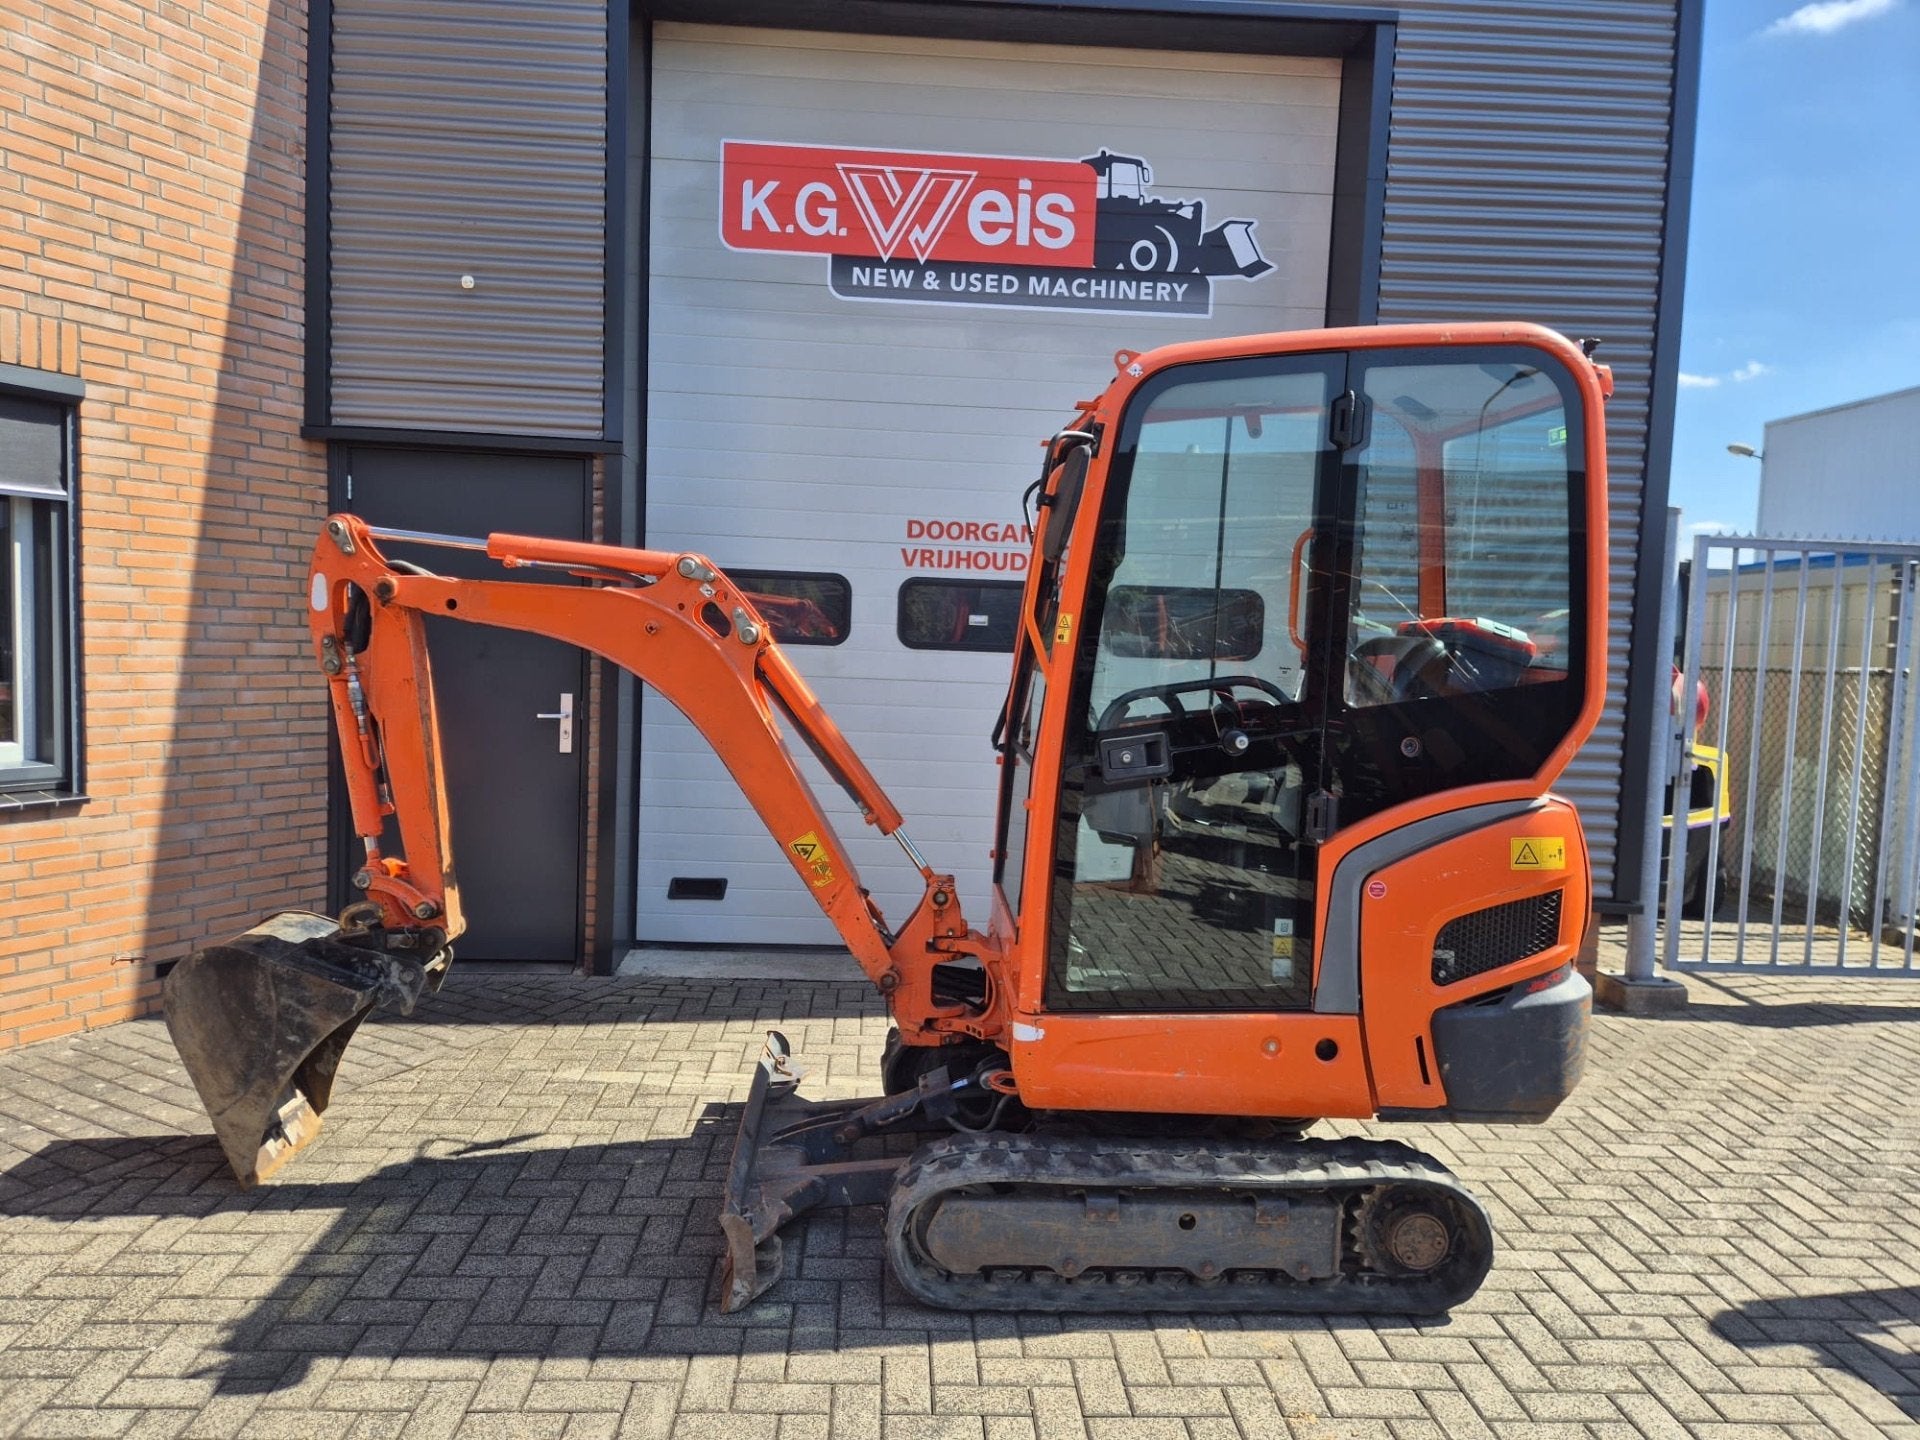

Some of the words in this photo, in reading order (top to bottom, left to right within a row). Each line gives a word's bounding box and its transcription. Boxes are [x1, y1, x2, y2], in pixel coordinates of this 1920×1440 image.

[741, 179, 848, 237] K.G.
[835, 163, 1076, 265] Weis
[851, 266, 915, 289] NEW
[922, 271, 940, 290] &
[949, 272, 1020, 296] USED
[1028, 276, 1190, 303] MACHINERY
